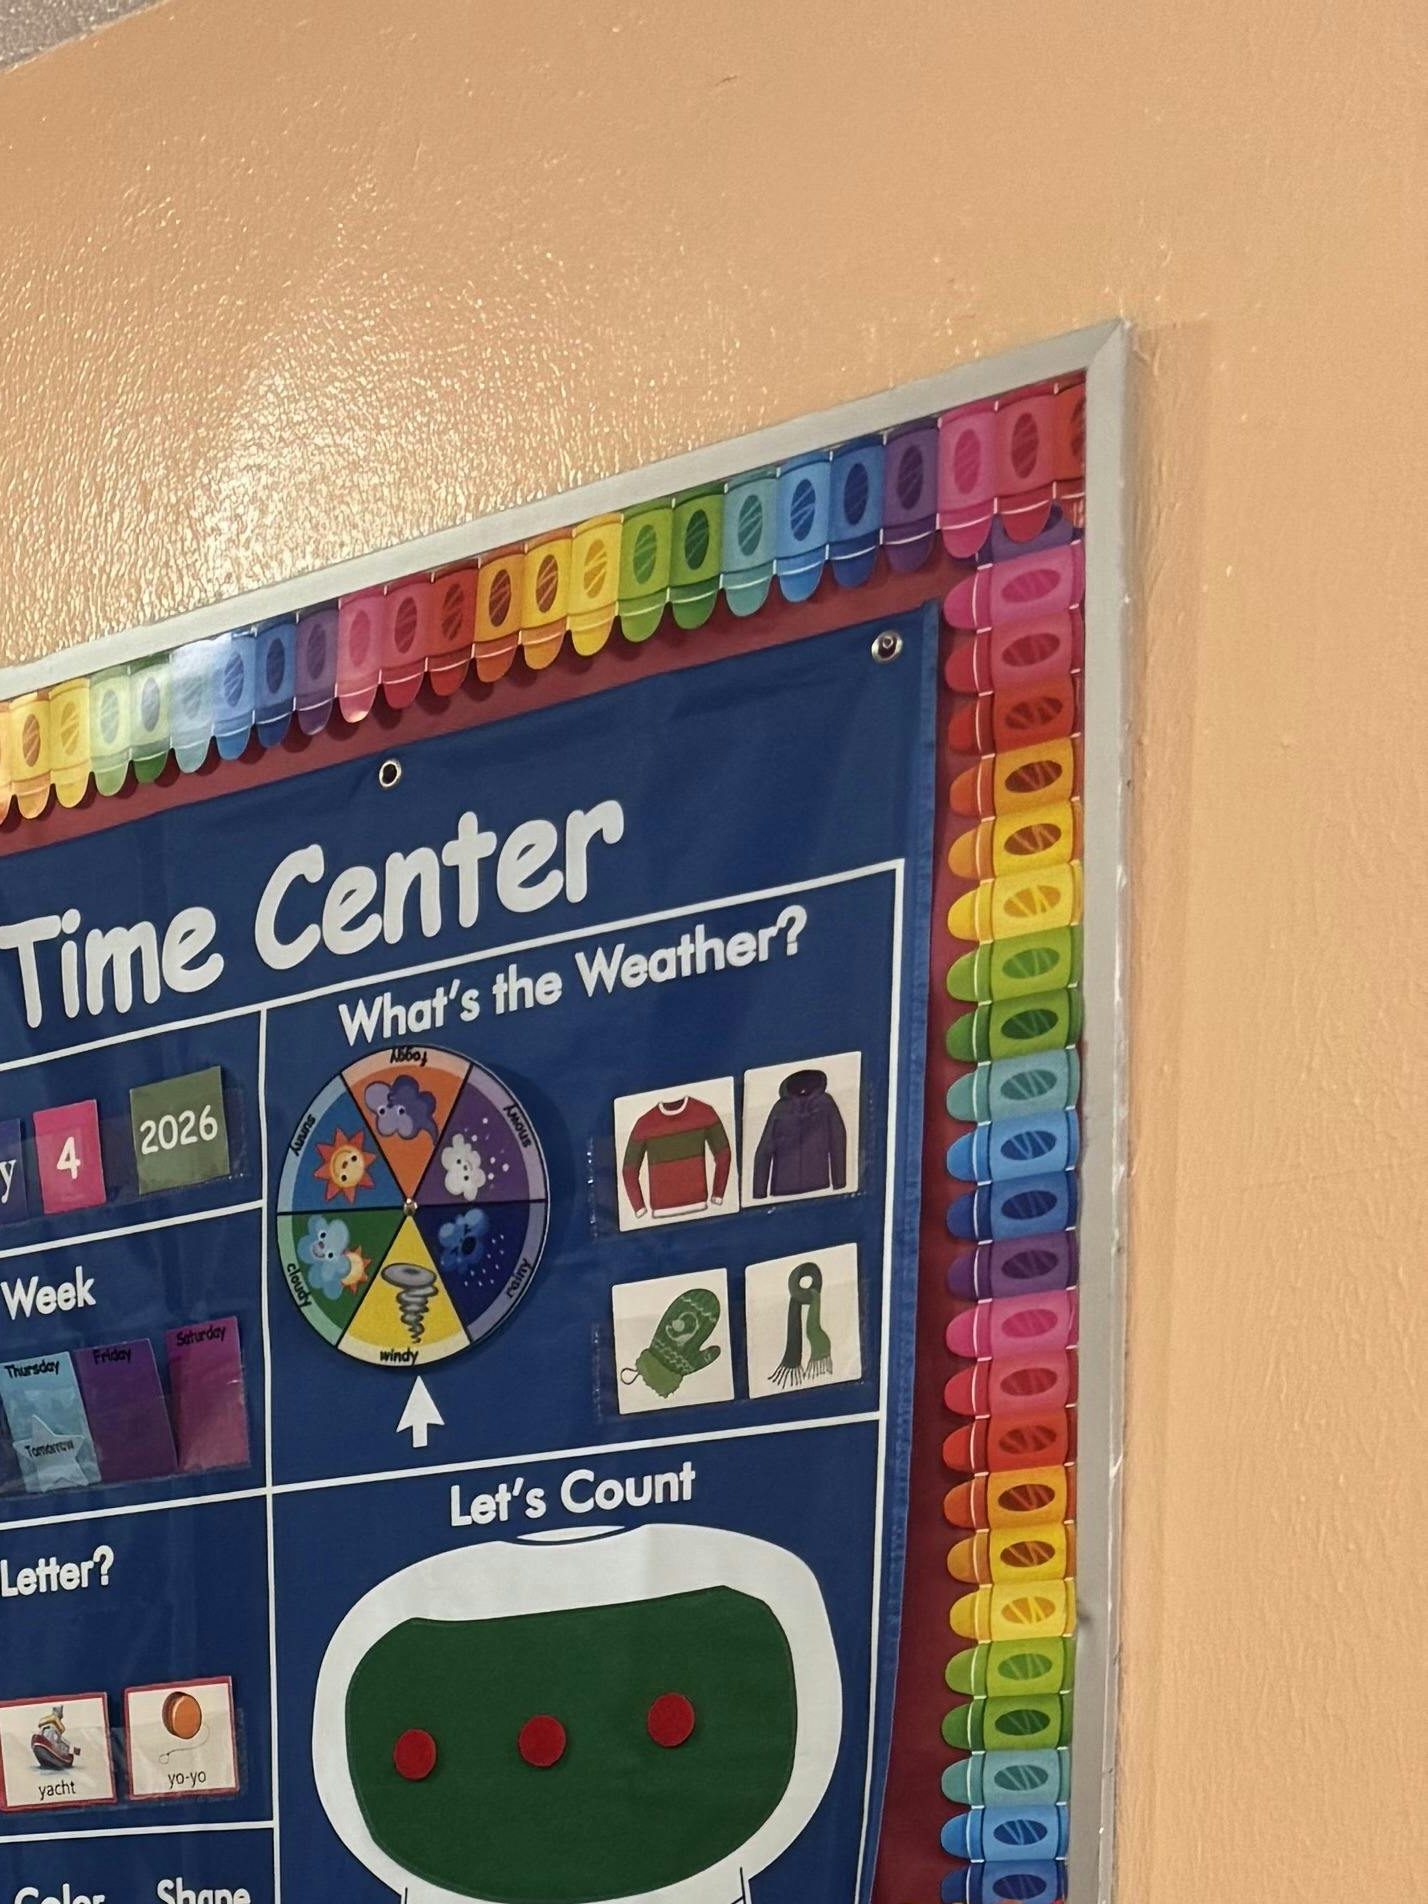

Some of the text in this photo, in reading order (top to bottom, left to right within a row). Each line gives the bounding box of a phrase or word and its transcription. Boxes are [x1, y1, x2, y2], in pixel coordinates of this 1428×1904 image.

[254, 799, 625, 970] Center
[338, 905, 808, 1047] What's the Weather?
[390, 1046, 428, 1067] foggy
[56, 1136, 82, 1180] 4
[139, 1104, 218, 1155] 2026
[289, 1114, 316, 1156] sunny
[503, 1104, 532, 1148] snowy
[0, 1265, 97, 1320] Week
[287, 1262, 313, 1308] cloudy
[93, 1348, 132, 1366] Friday
[176, 1325, 226, 1347] Saturday
[380, 1347, 419, 1366] windy
[4, 1359, 61, 1379] Thursday
[450, 1461, 696, 1527] Let's Count
[0, 1544, 115, 1597] Letter?
[38, 1778, 77, 1800] yacht
[168, 1767, 208, 1791] yo-yo
